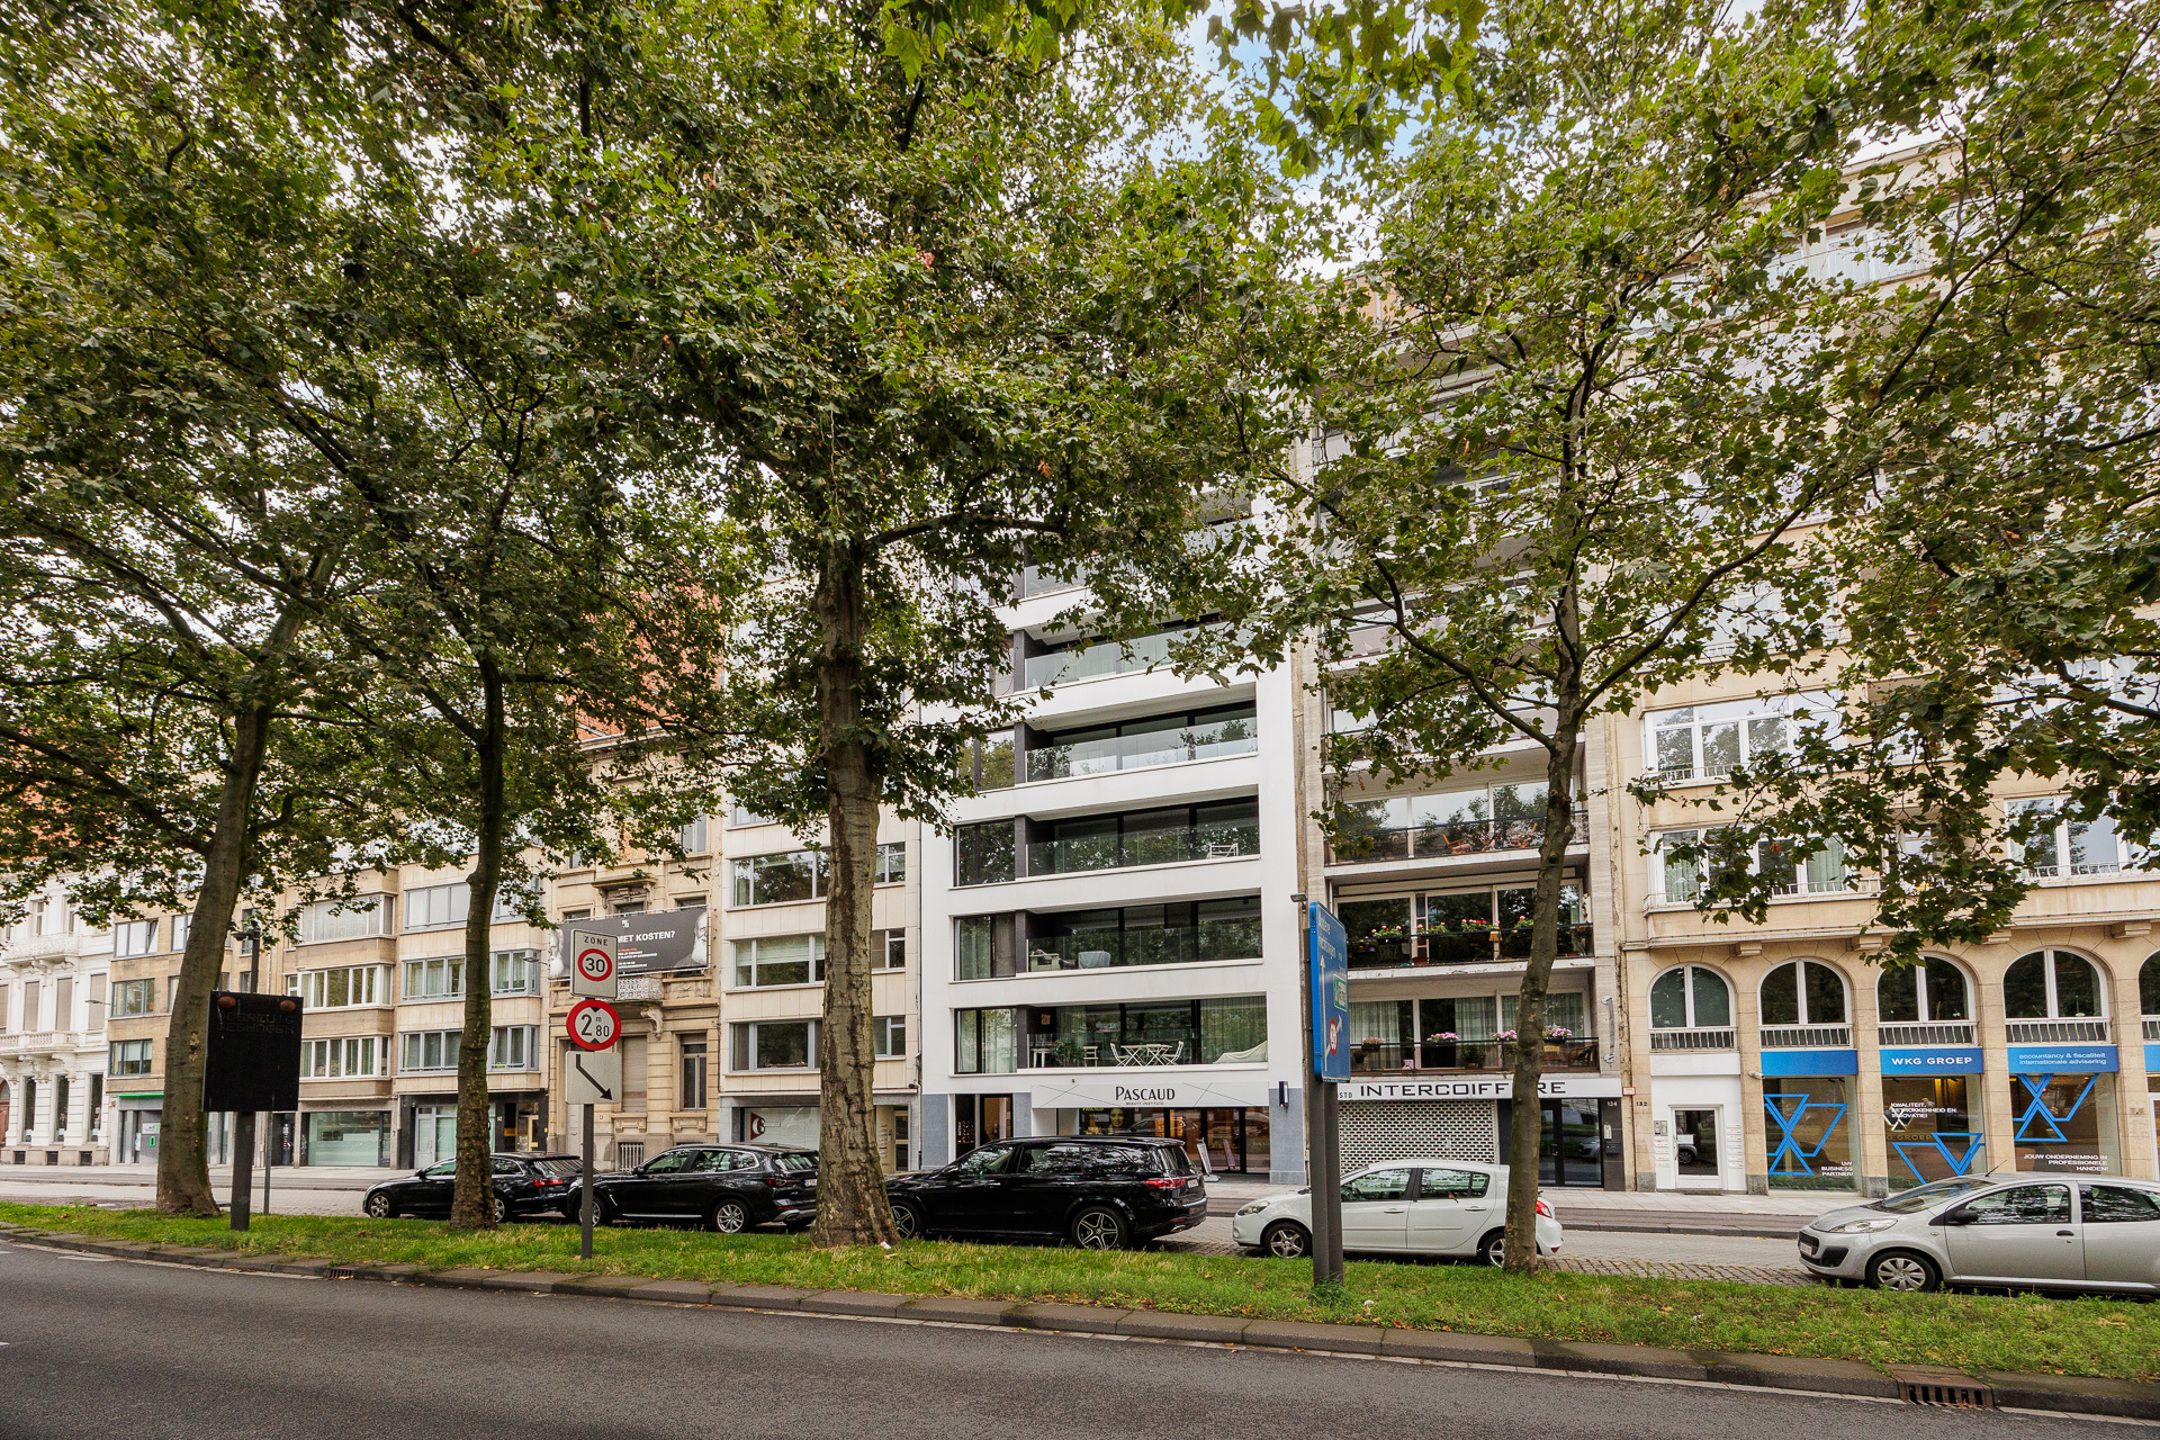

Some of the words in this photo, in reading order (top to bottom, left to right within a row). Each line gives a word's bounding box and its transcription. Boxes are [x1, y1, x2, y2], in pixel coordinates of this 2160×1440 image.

[584, 935, 608, 947] ZONE
[636, 930, 676, 942] KOSTEN?
[585, 957, 606, 973] 30
[580, 1013, 592, 1036] 2
[596, 1024, 610, 1037] 80
[1891, 1057, 1921, 1065] WKG
[1927, 1056, 1972, 1065] GROEP
[1360, 1081, 1566, 1098] INTERCOIFFRE
